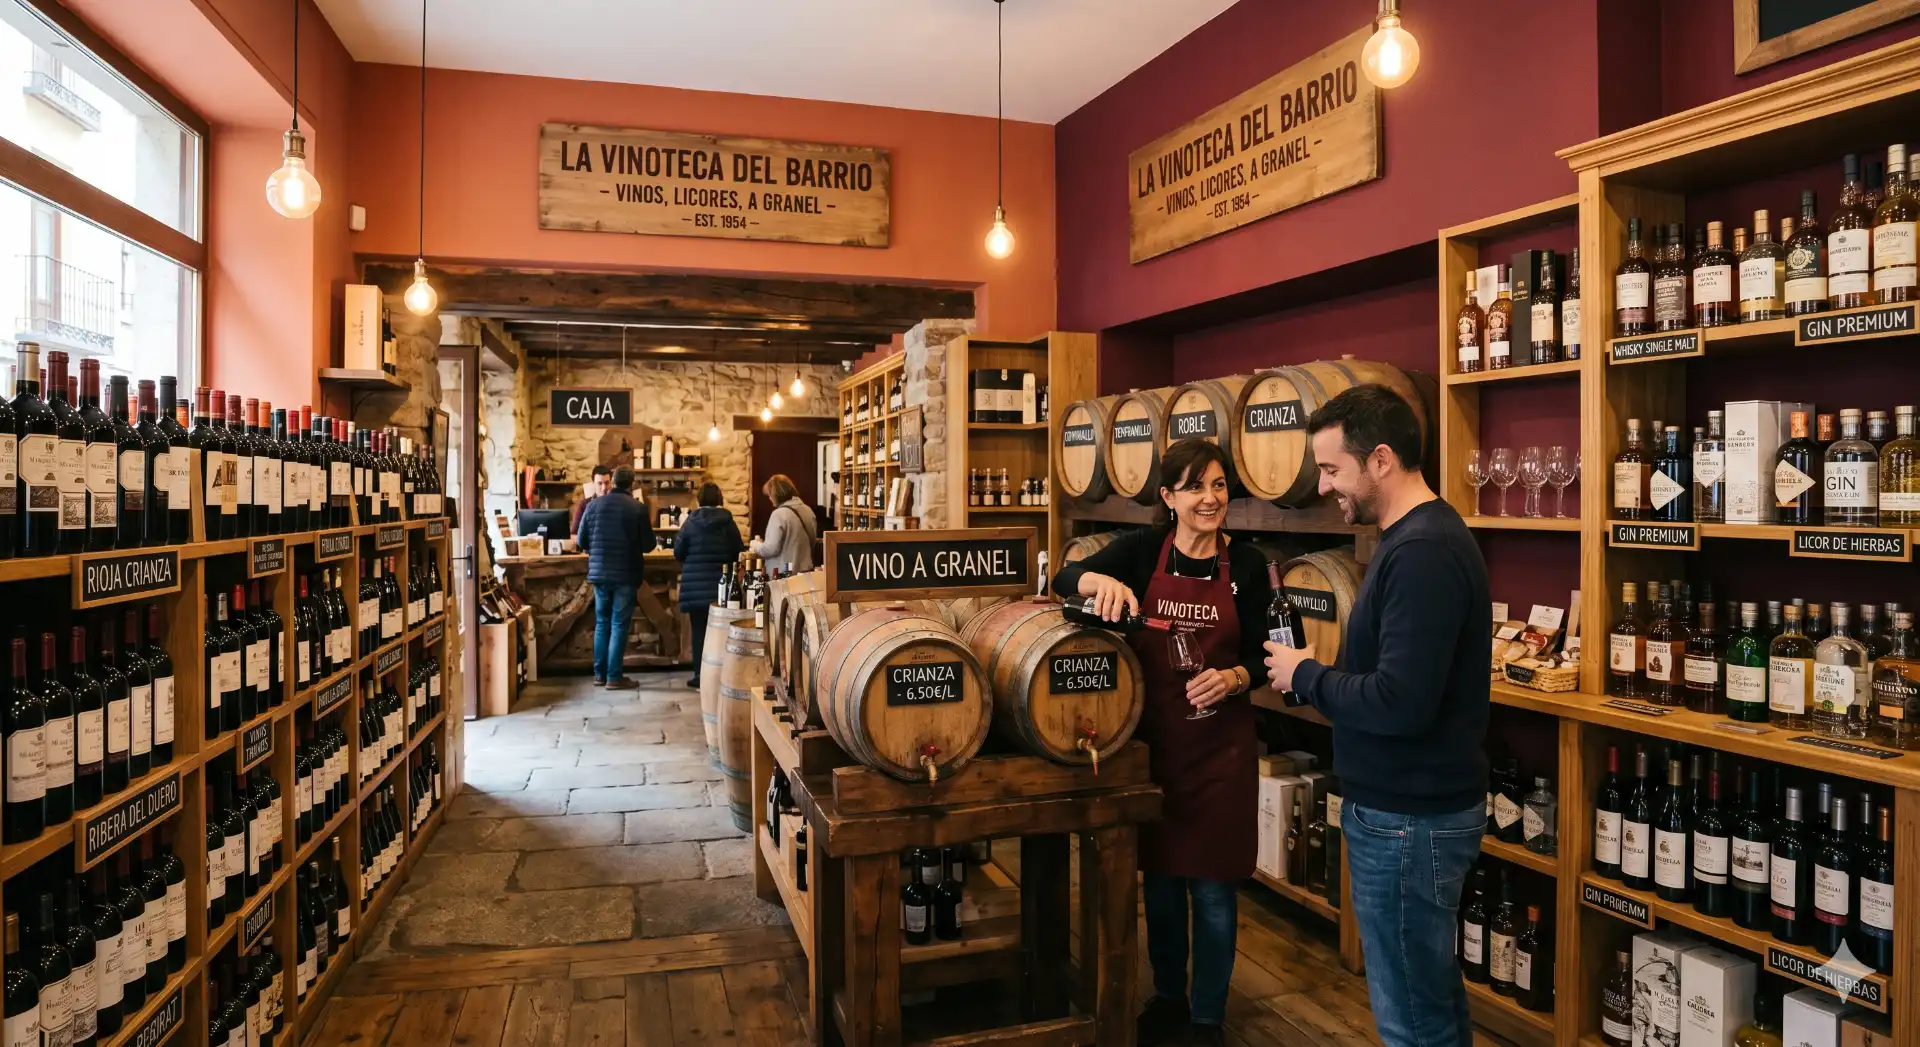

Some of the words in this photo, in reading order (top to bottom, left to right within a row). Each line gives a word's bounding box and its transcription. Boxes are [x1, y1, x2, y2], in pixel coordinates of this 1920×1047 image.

[1137, 162, 1155, 199] LA
[1158, 122, 1235, 188] VINOTECA
[1240, 104, 1274, 152] DEL
[1280, 60, 1358, 134] BARRIO
[561, 141, 592, 172] LA
[601, 143, 724, 182] VINOTECA
[733, 153, 777, 186] DEL
[786, 157, 872, 192] BARRIO
[1166, 183, 1198, 216] VINOS,
[1200, 162, 1247, 202] LICORES,
[1249, 157, 1258, 182] A
[1261, 135, 1311, 177] GRANEL
[616, 183, 668, 207] VINOS,
[674, 187, 742, 212] LICORES,
[748, 192, 758, 210] A
[763, 192, 822, 214] GRANEL
[1214, 199, 1230, 219] EST.
[1231, 193, 1251, 213] 1954
[695, 214, 718, 228] EST.
[720, 215, 747, 230] 1954
[1807, 320, 1831, 338] GIN
[1837, 310, 1908, 334] PREMIUM
[1614, 341, 1643, 357] WHISKY
[1646, 339, 1673, 354] SINGLE
[1675, 337, 1697, 351] MALT
[566, 396, 615, 419] CAJA
[1250, 405, 1297, 428] CRIANZA
[1178, 414, 1207, 435] ROBLE
[1826, 476, 1856, 490] GIN
[1619, 527, 1636, 541] GIN
[1639, 527, 1689, 544] PREMIUM
[1798, 535, 1830, 550] LICOR
[1833, 536, 1848, 551] DE
[1851, 537, 1901, 552] HIERBAS
[87, 563, 123, 595] RIOJA
[125, 557, 172, 586] CRIANZA
[849, 552, 905, 581] VINO
[912, 552, 928, 578] A
[934, 550, 1017, 577] GRANEL
[1157, 598, 1219, 621] VINOTECA
[893, 666, 955, 684] CRIANZA
[1054, 656, 1110, 674] CRIANZA
[906, 685, 955, 701] 6.50€/L
[1066, 674, 1110, 689] 6.50€/L
[89, 814, 127, 853] RIBERA
[129, 801, 147, 828] DEL
[148, 780, 177, 816] DUERO
[1585, 887, 1601, 903] GIN
[1772, 951, 1804, 975] LICOR
[1807, 964, 1822, 982] DE
[1825, 970, 1878, 1001] HIERBAS
